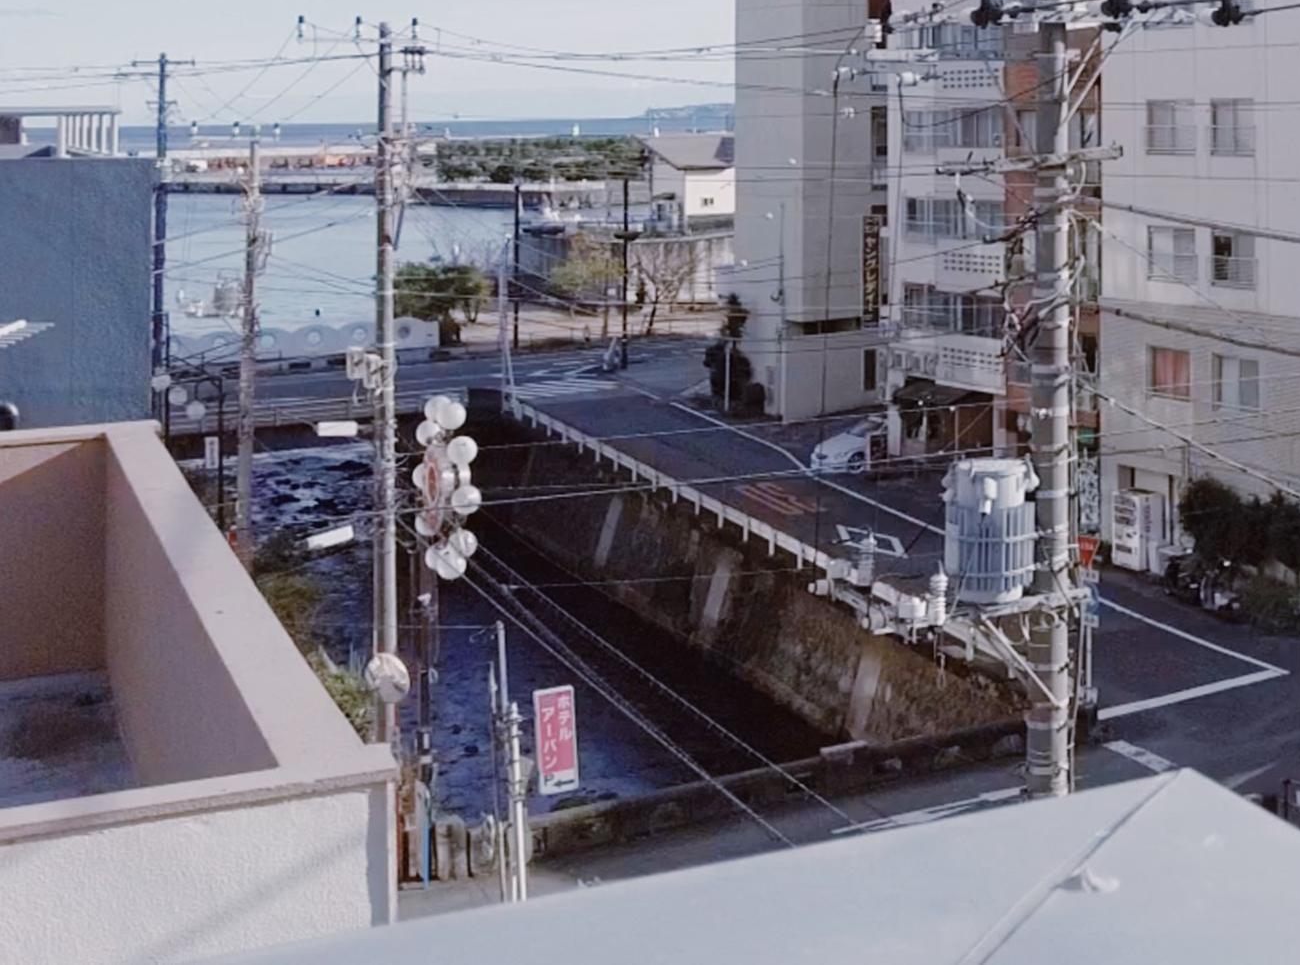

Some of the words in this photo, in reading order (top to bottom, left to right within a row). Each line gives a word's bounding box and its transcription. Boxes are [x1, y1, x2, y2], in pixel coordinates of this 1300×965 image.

[541, 706, 557, 770] アーバン
[558, 695, 573, 741] ホテル
[544, 774, 554, 787] P
